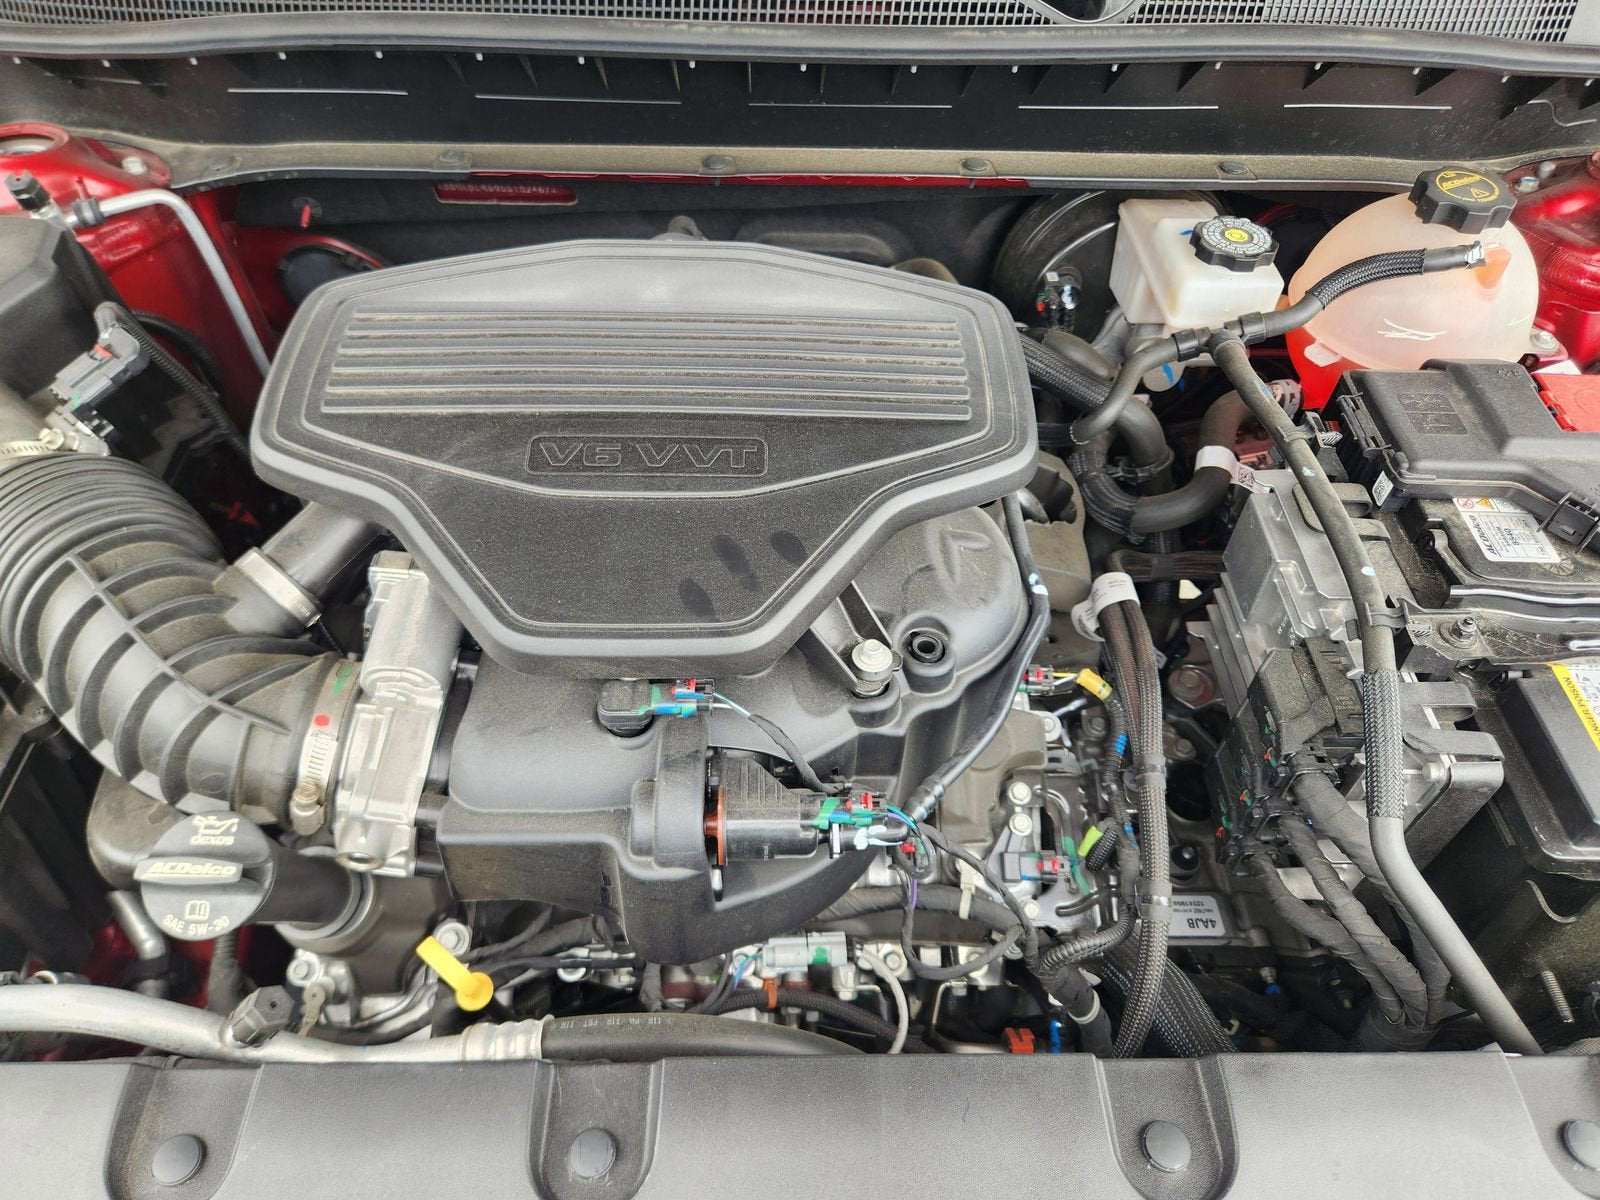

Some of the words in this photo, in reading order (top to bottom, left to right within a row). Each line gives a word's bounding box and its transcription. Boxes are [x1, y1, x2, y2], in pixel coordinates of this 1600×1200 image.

[539, 442, 622, 466] V6
[636, 443, 758, 468] VVT
[1563, 677, 1585, 707] POISON
[191, 835, 235, 846] dexos
[146, 861, 238, 876] ACDelco
[162, 914, 185, 933] SAE
[187, 915, 230, 936] 5W-30
[1187, 918, 1216, 928] 4AJB
